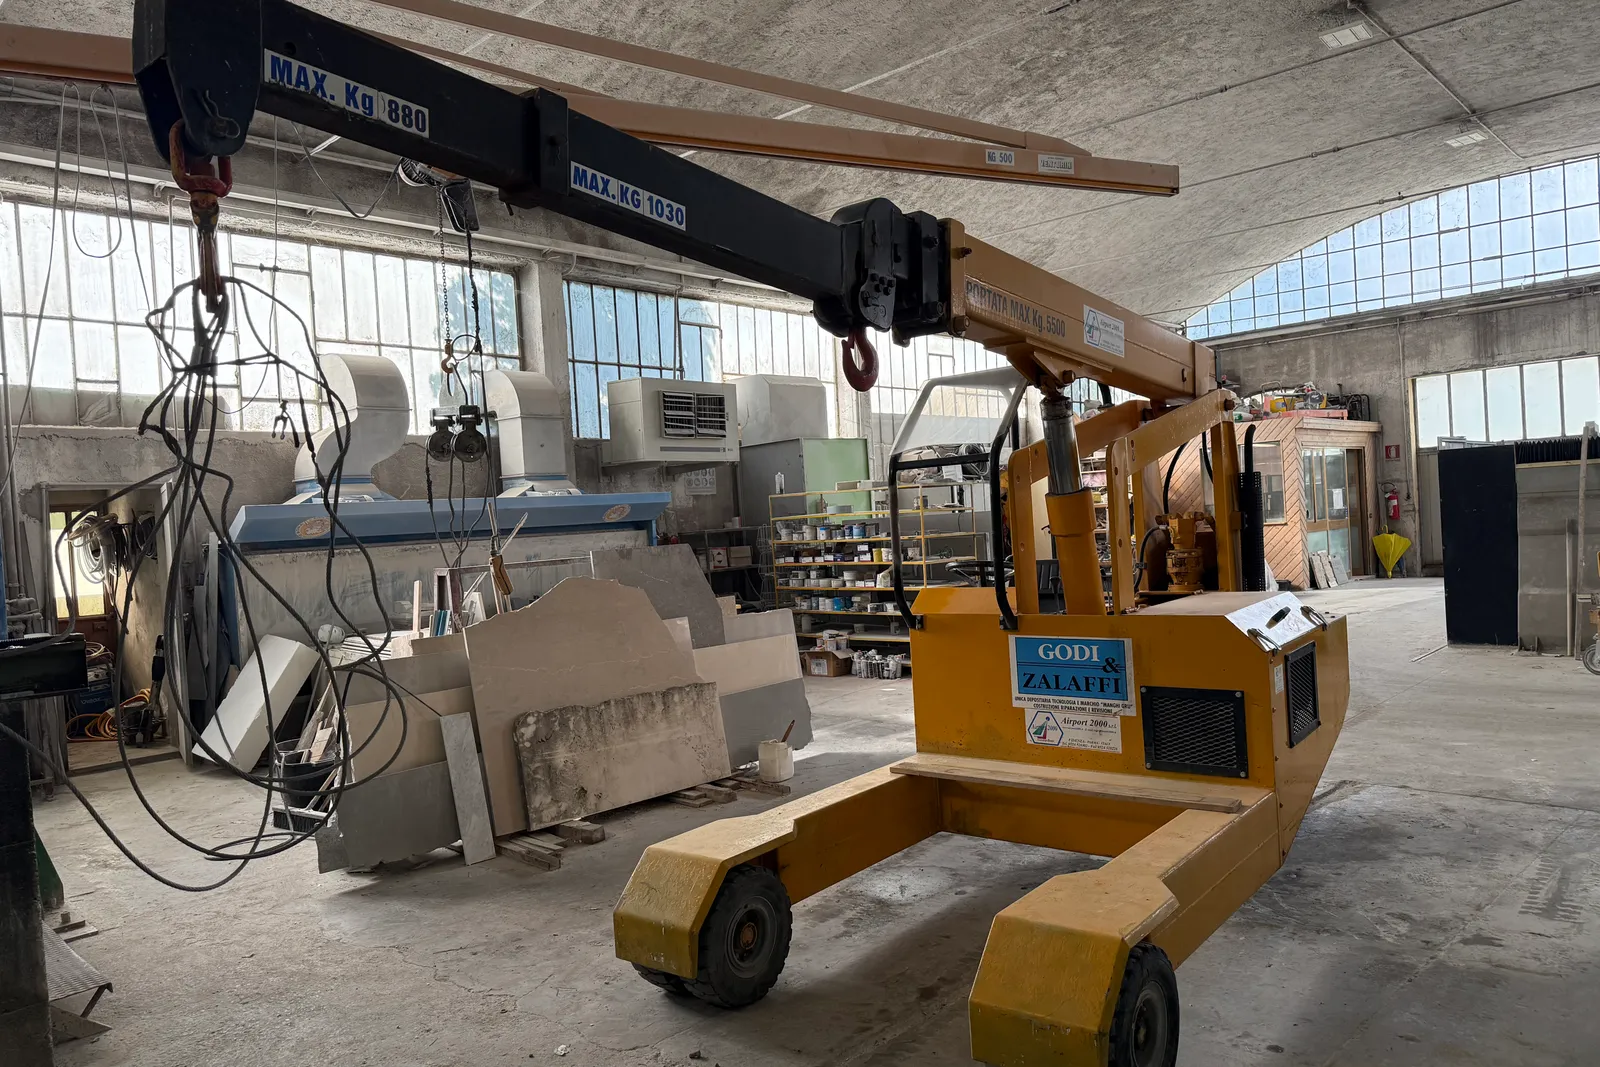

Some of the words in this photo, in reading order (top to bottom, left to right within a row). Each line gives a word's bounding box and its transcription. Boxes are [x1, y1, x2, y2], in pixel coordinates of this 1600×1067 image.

[270, 54, 336, 100] MAX.
[344, 81, 374, 117] Kg
[387, 98, 427, 133] 880
[987, 151, 996, 162] KG
[999, 152, 1013, 164] 500
[572, 165, 617, 200] MAX.
[619, 183, 642, 209] KG
[646, 194, 685, 226] 1030
[966, 280, 1008, 315] PORTATA
[1010, 299, 1031, 325] MAX
[1047, 315, 1066, 338] 5500
[1038, 643, 1100, 662] GODI
[1102, 656, 1121, 674] &
[1022, 671, 1121, 694] ZALAFFI
[1061, 717, 1088, 727] Airport
[1089, 719, 1108, 728] 2000
